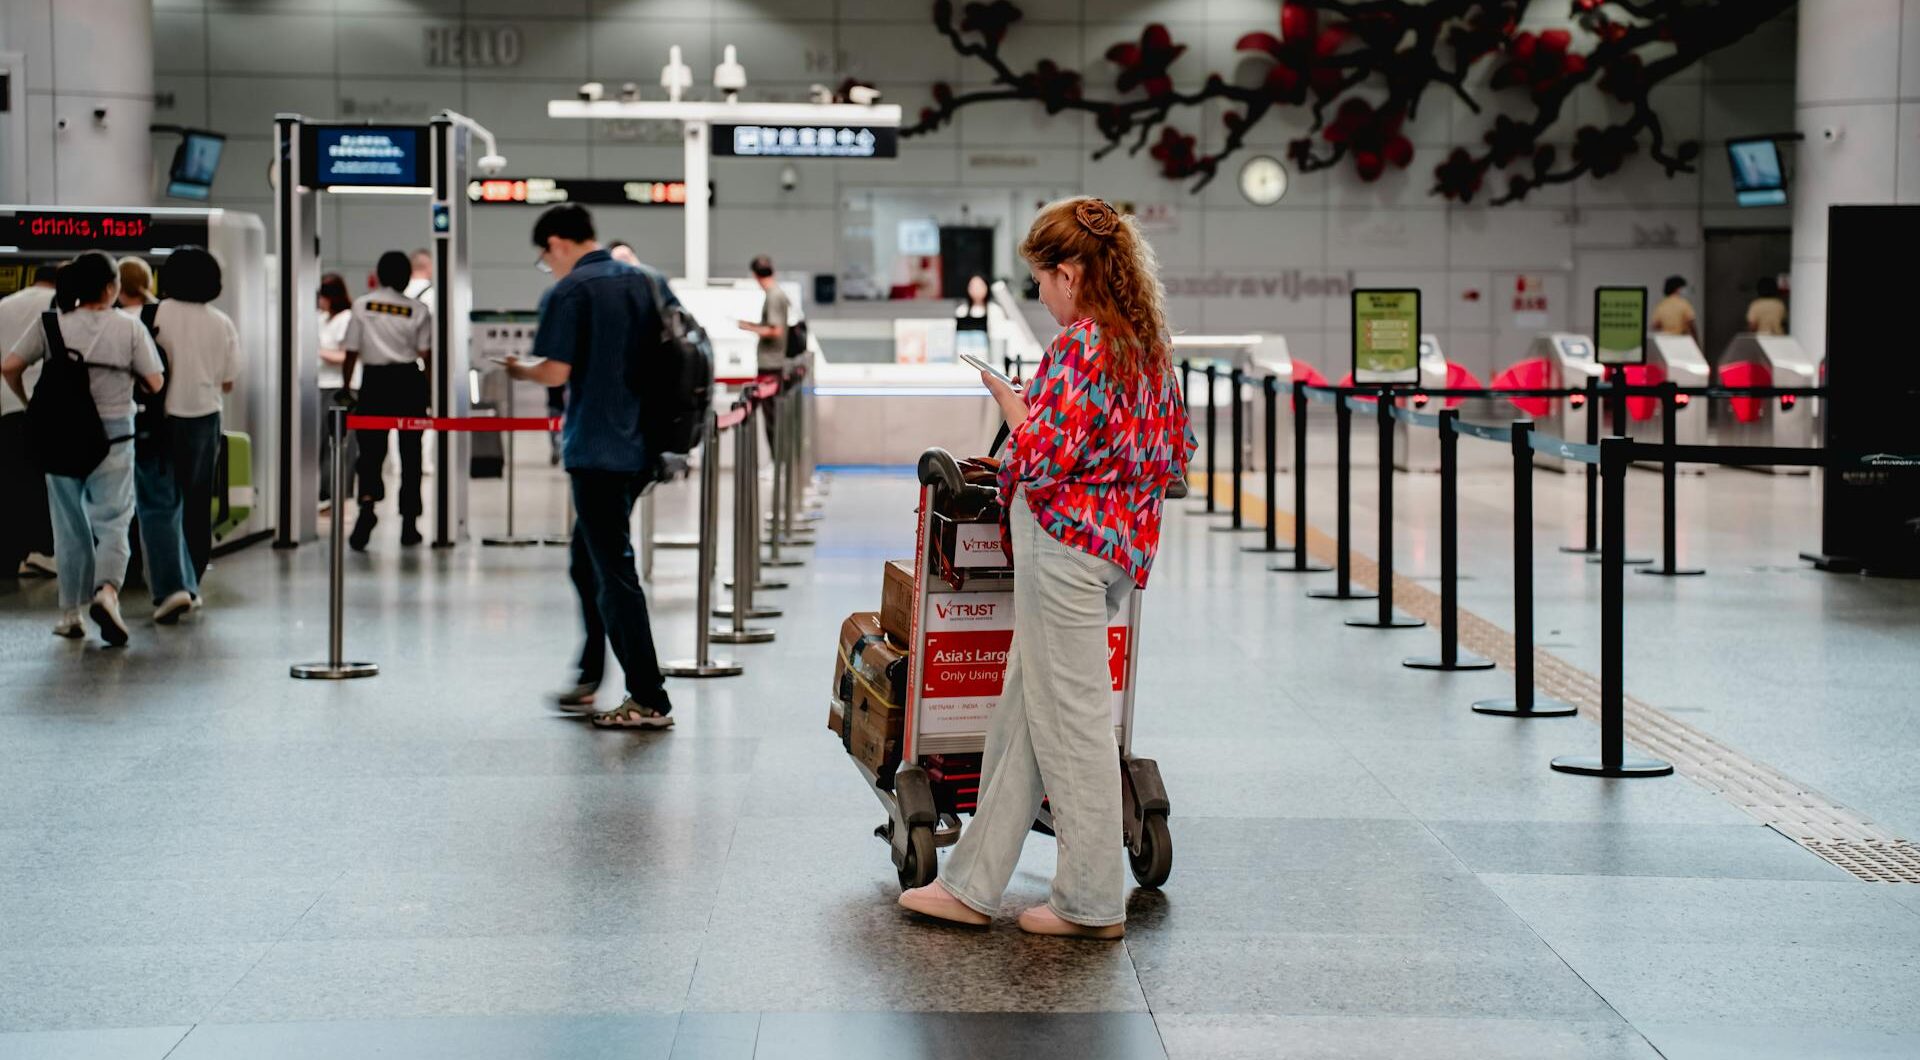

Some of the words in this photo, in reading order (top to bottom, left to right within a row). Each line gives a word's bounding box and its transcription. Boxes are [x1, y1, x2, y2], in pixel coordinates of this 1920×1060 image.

[423, 26, 523, 67] HELLO
[31, 217, 97, 239] drinks,
[933, 650, 972, 662] Asia's
[940, 671, 966, 682] Only
[969, 670, 998, 681] Using
